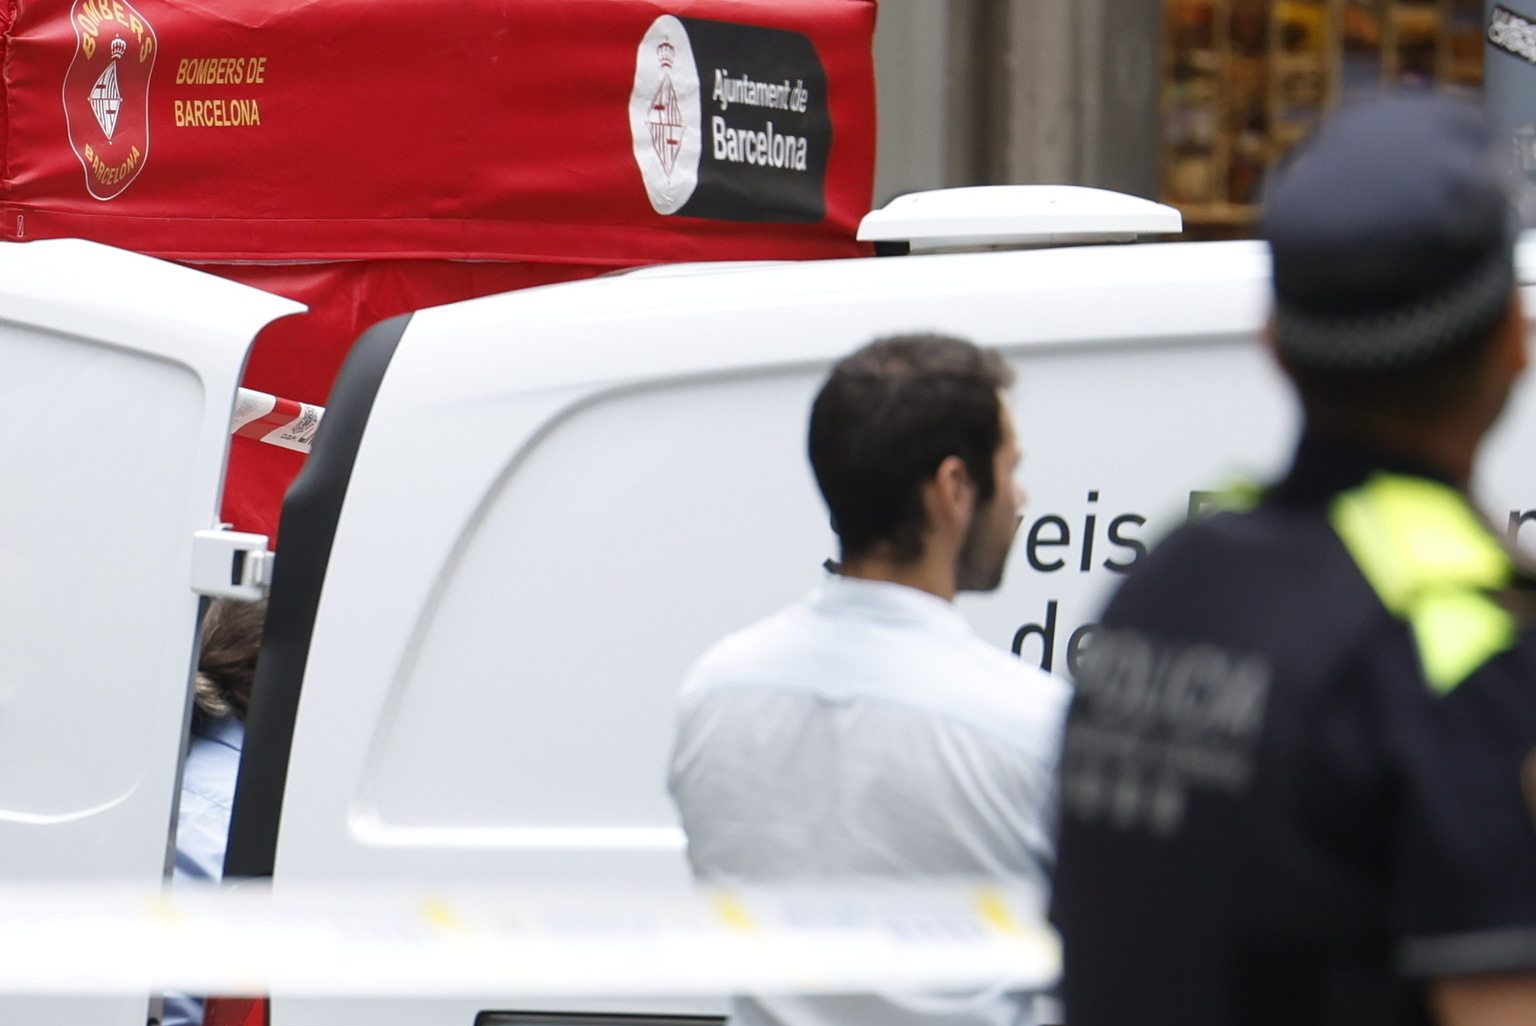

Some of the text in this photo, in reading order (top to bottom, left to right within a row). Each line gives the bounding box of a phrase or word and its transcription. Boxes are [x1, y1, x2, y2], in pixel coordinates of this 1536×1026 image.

[77, 0, 153, 63] BOMBERS
[176, 57, 267, 85] BOMBERS DE
[712, 68, 808, 113] Ajuntament de
[174, 99, 261, 127] BARCELONA
[84, 143, 141, 185] BARCELONA
[712, 115, 807, 171] Barcelona
